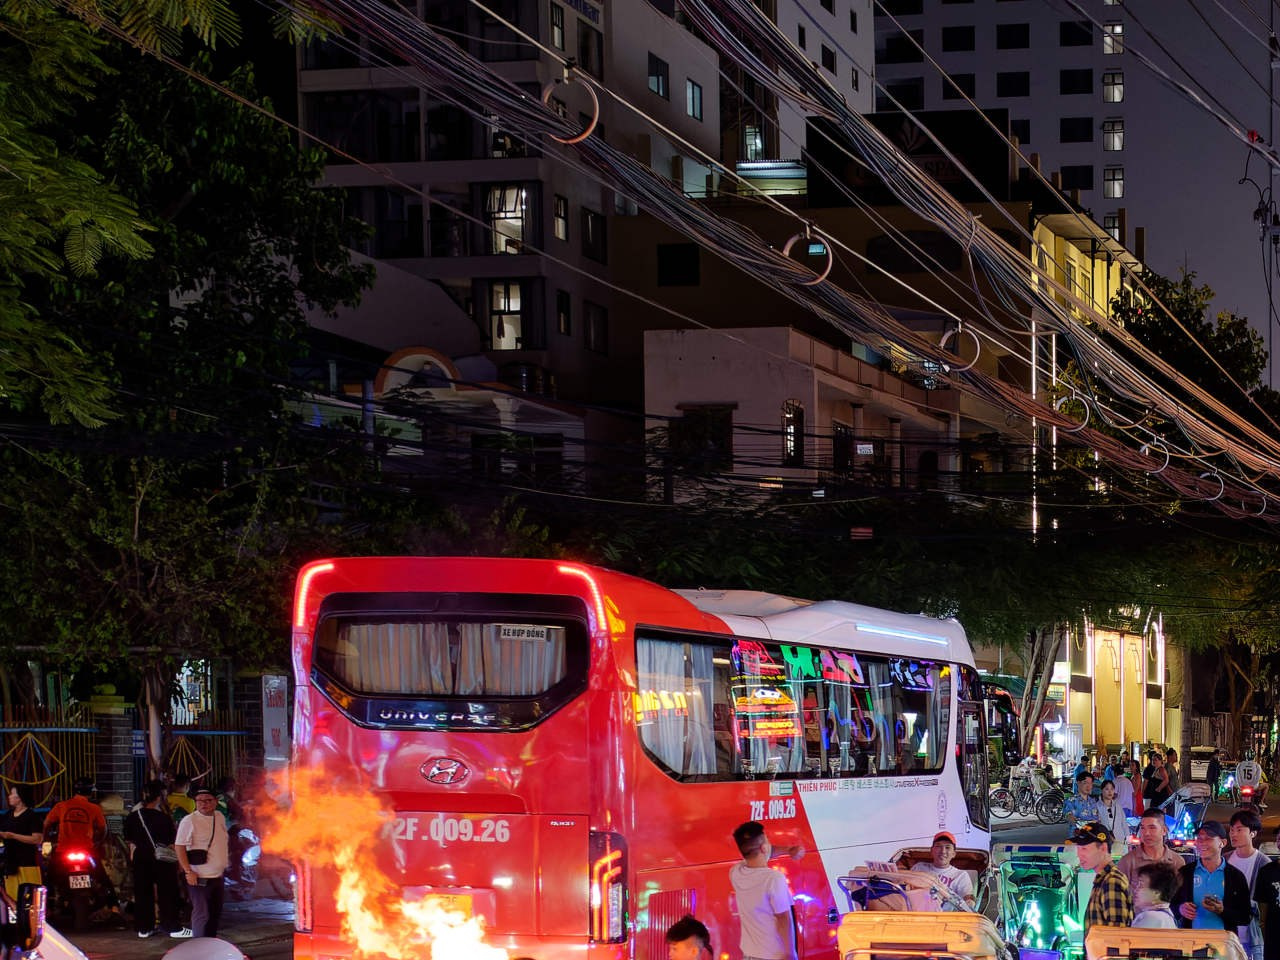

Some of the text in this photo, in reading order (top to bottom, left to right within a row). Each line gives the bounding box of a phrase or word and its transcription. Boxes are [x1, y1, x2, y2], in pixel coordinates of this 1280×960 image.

[502, 628, 511, 637] XE
[1243, 768, 1252, 780] 15
[750, 799, 796, 820] 72F.009.26
